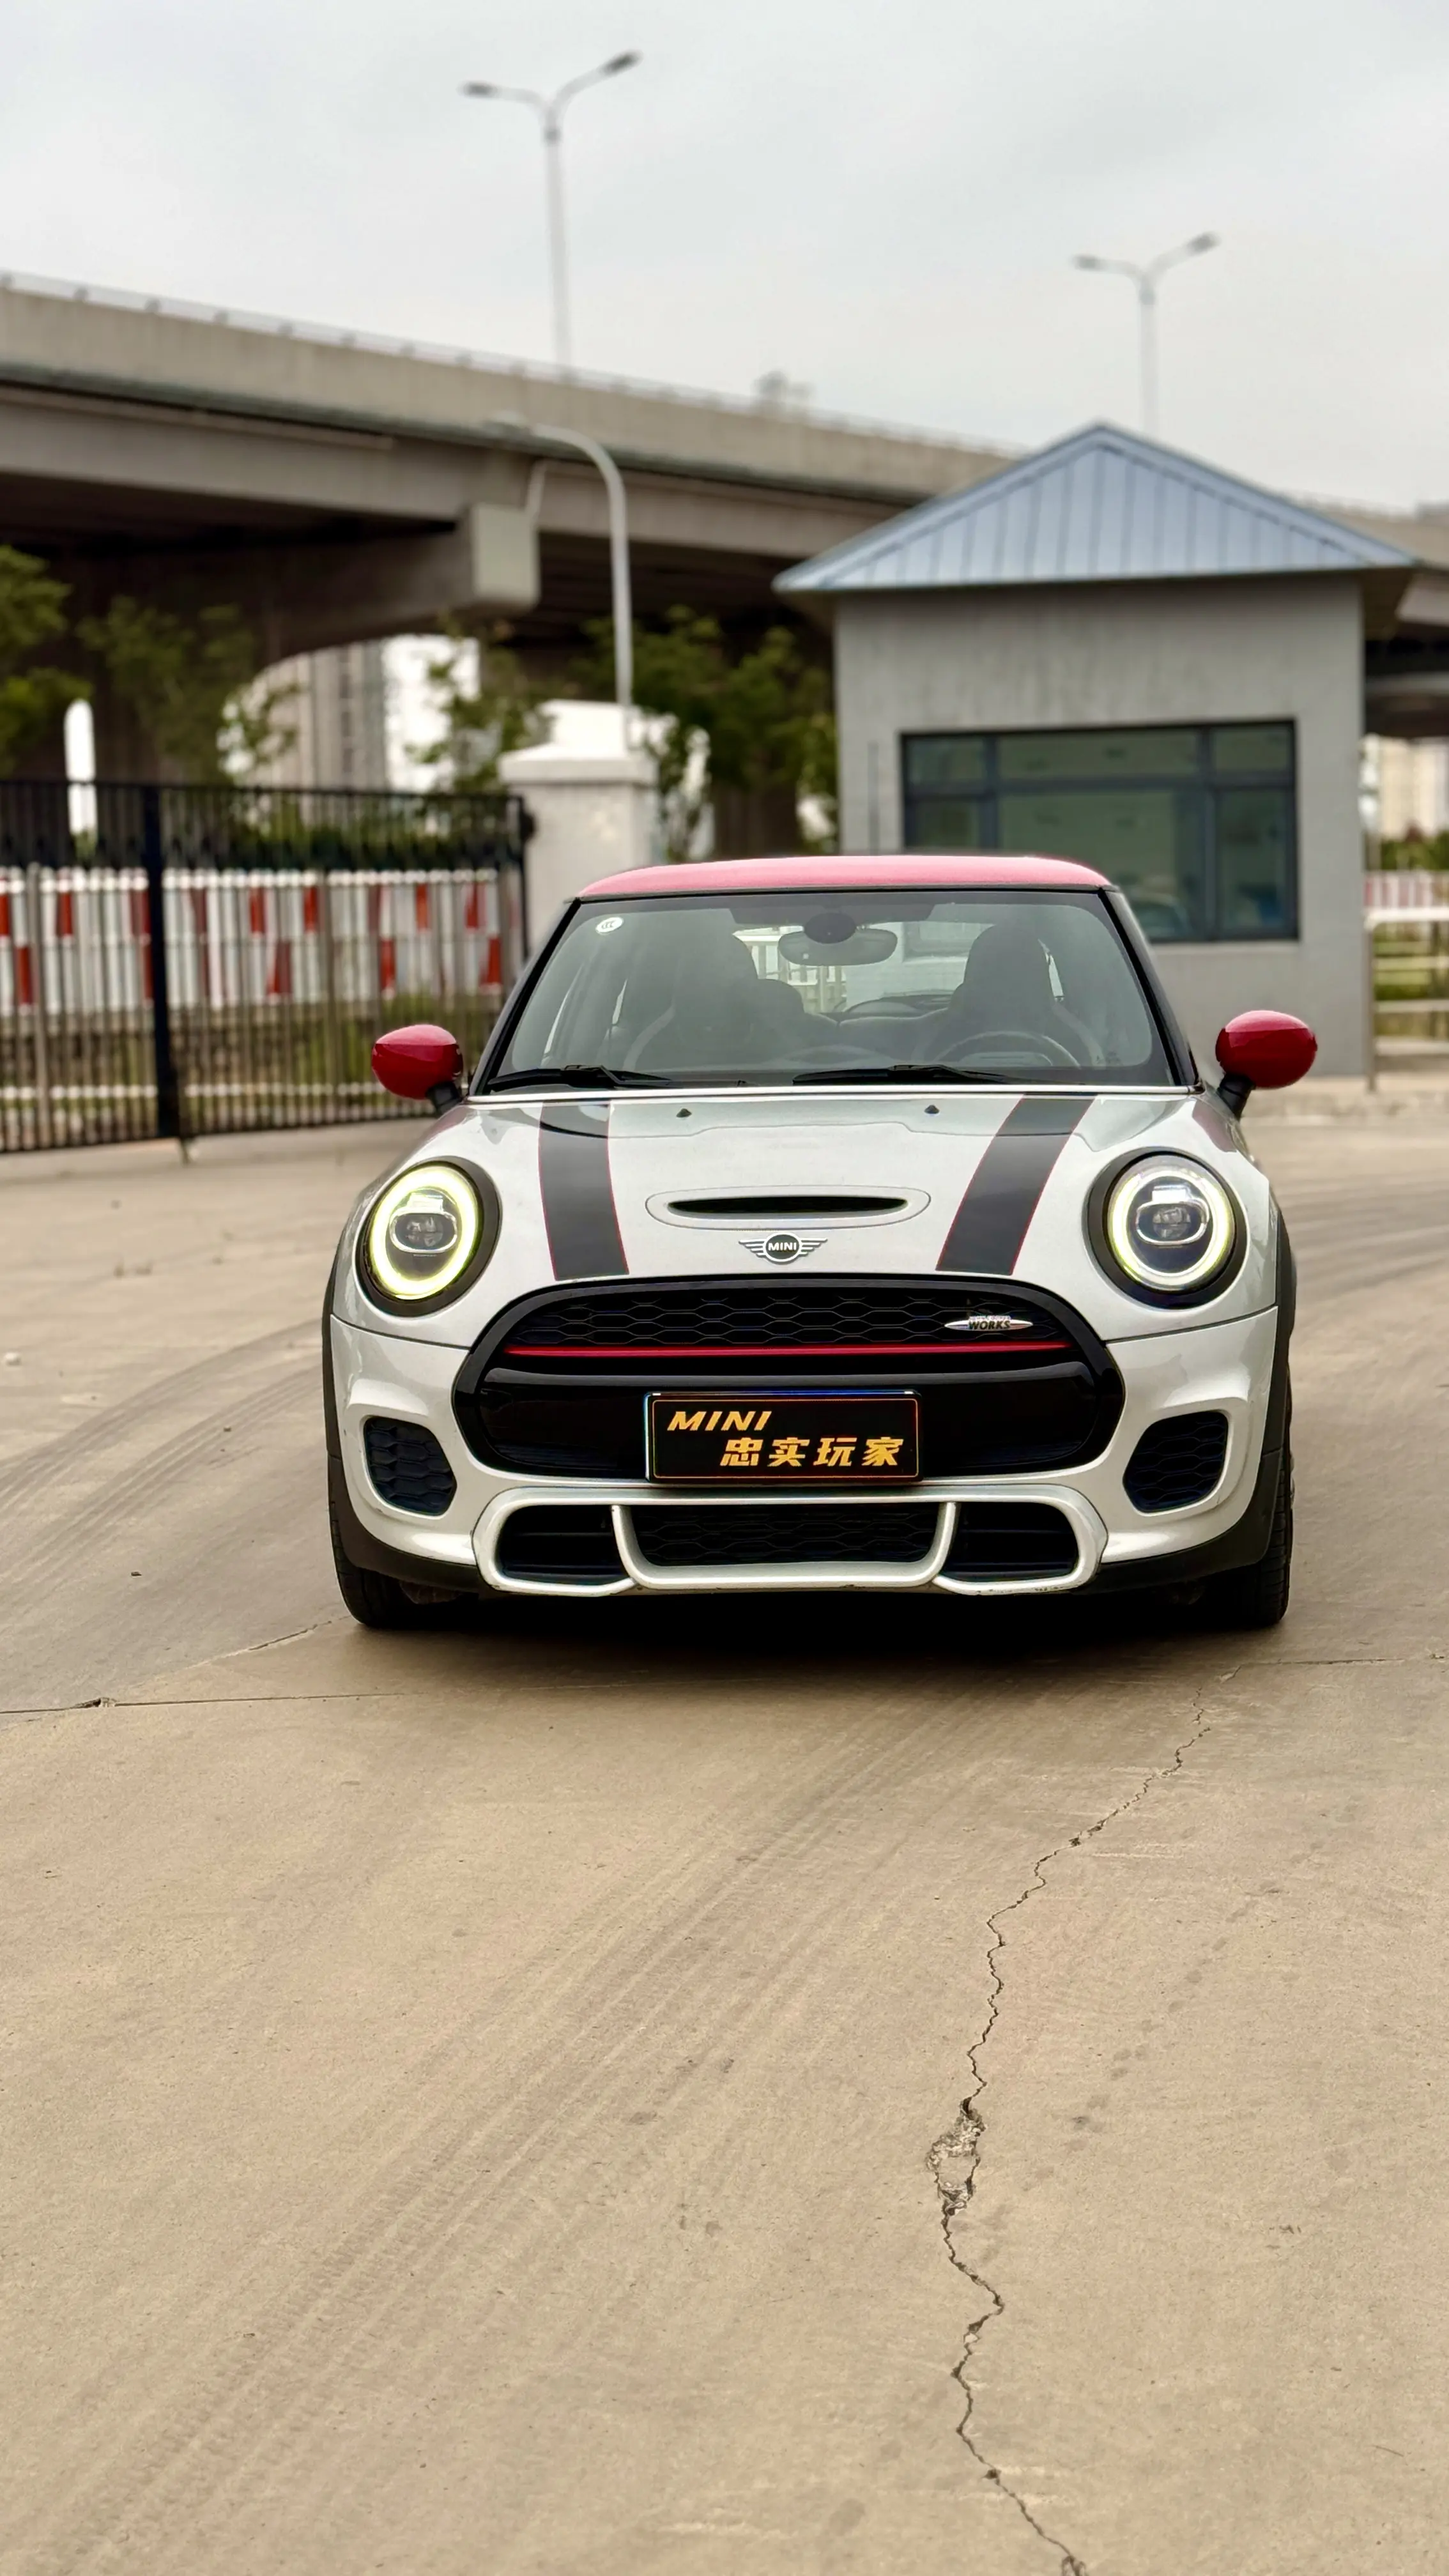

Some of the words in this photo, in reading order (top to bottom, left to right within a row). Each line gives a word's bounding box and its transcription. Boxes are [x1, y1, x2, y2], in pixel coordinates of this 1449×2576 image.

[768, 1242, 797, 1252] MINI
[969, 1320, 1011, 1330] WORKS
[667, 1411, 772, 1431] MINI
[719, 1437, 904, 1467] 忠实玩家
